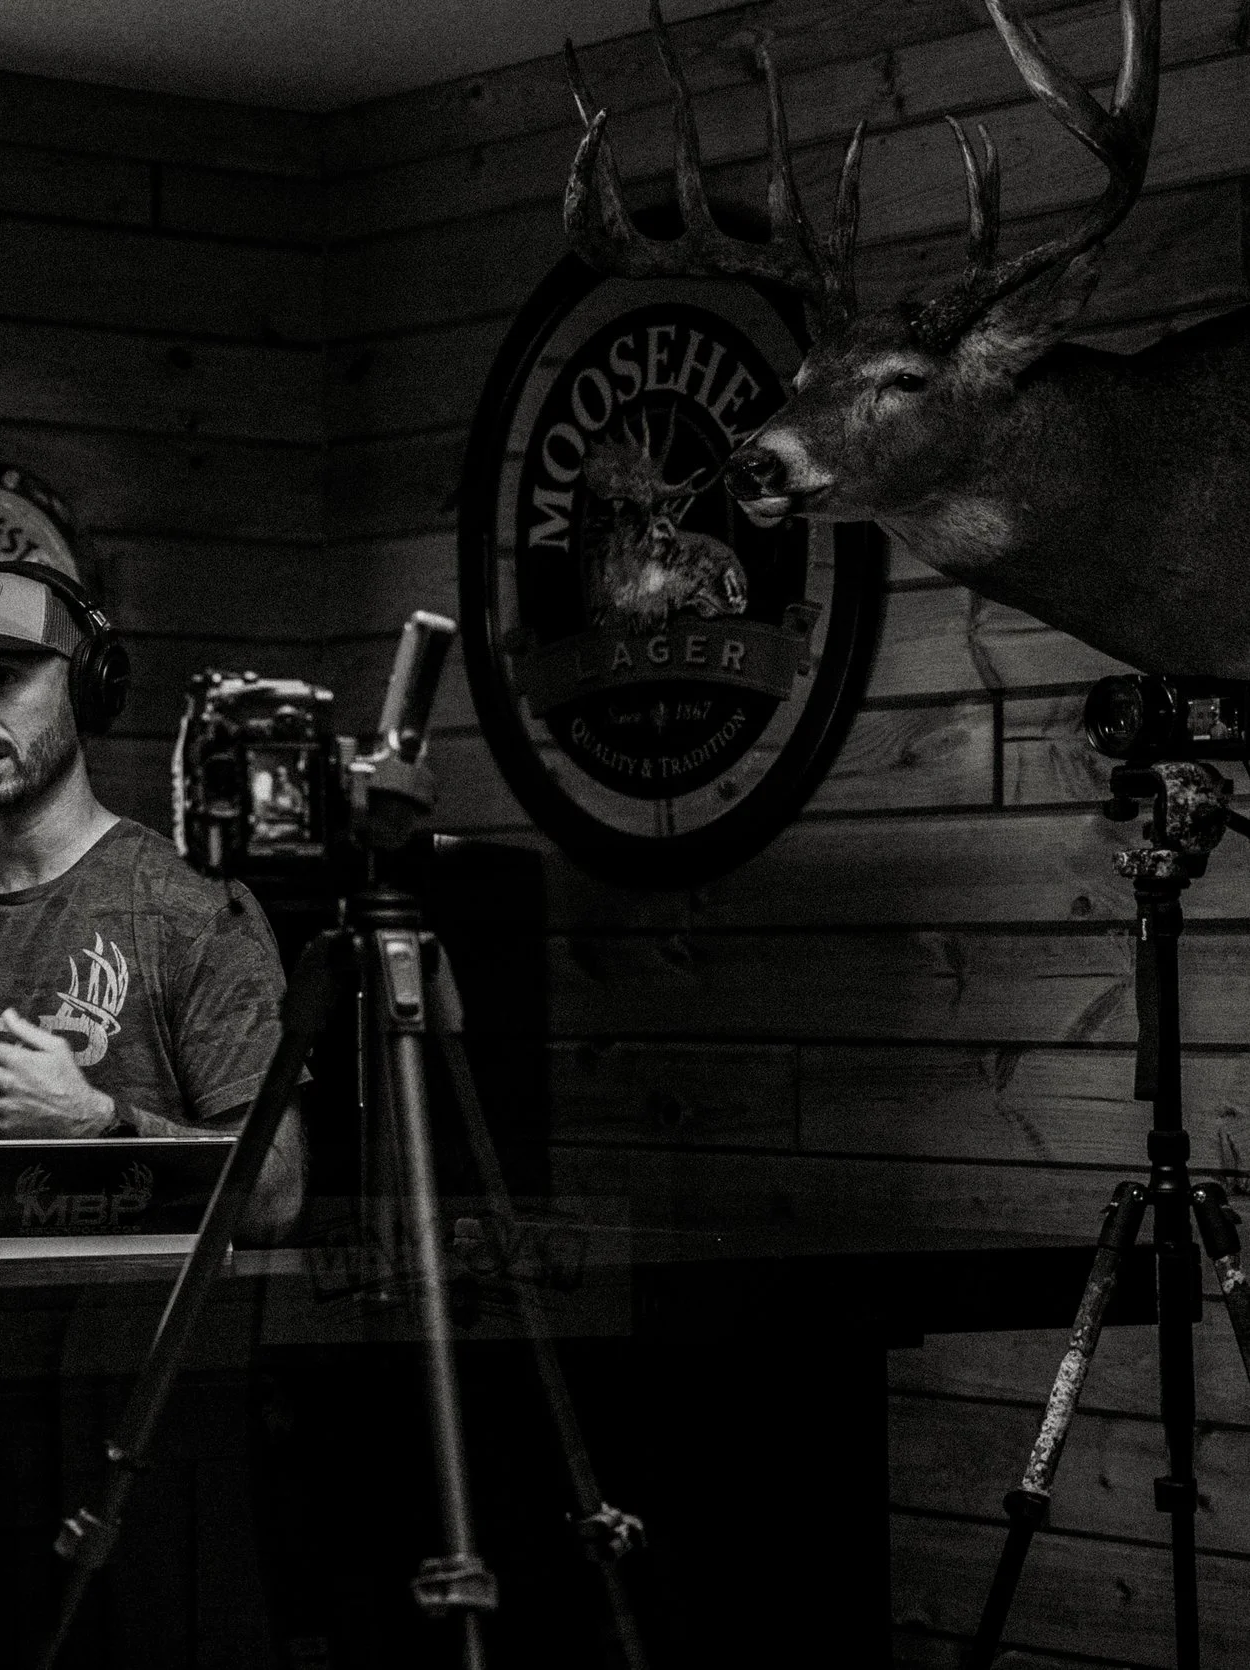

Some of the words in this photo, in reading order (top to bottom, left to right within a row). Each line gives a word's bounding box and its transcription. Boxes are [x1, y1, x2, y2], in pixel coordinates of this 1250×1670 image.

[527, 324, 762, 553] MOOSEHE
[570, 716, 638, 777] QUALITY
[640, 757, 654, 779] &
[658, 707, 747, 779] TRADITION
[15, 1193, 149, 1227] MBP
